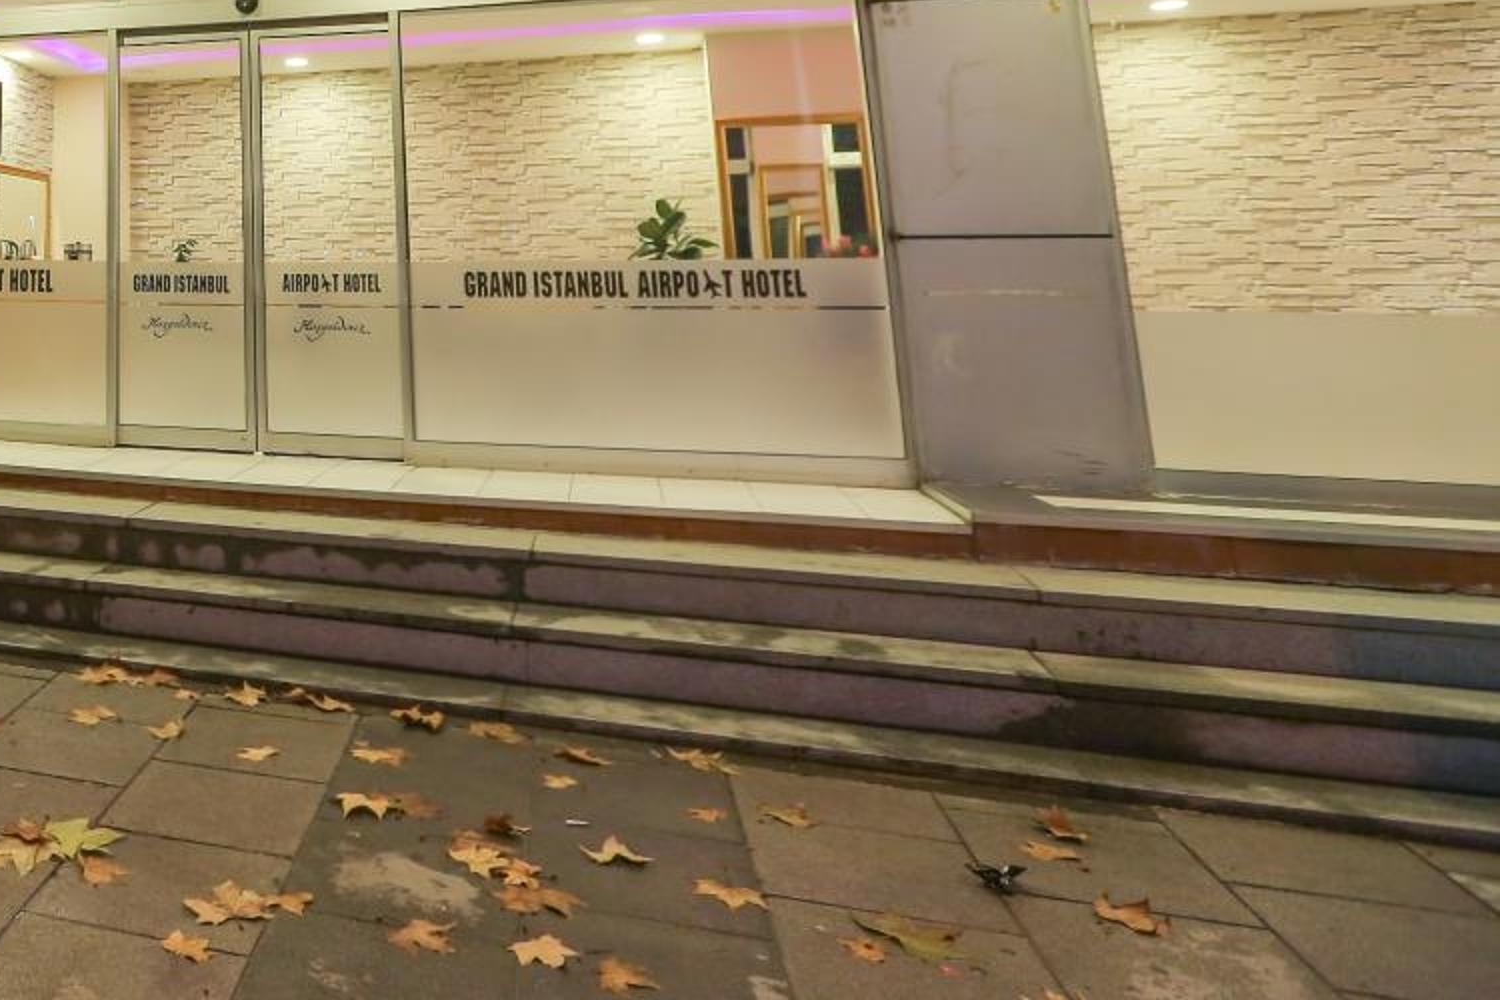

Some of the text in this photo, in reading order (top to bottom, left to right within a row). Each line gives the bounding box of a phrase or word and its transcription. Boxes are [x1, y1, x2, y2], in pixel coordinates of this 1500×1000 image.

[10, 270, 53, 293] HOTEL
[133, 274, 230, 294] GRAND ISTANBUL
[343, 273, 381, 293] HOTEL
[463, 271, 527, 297] GRAND
[533, 271, 628, 298] ISTANBUL
[741, 270, 806, 298] HOTEL
